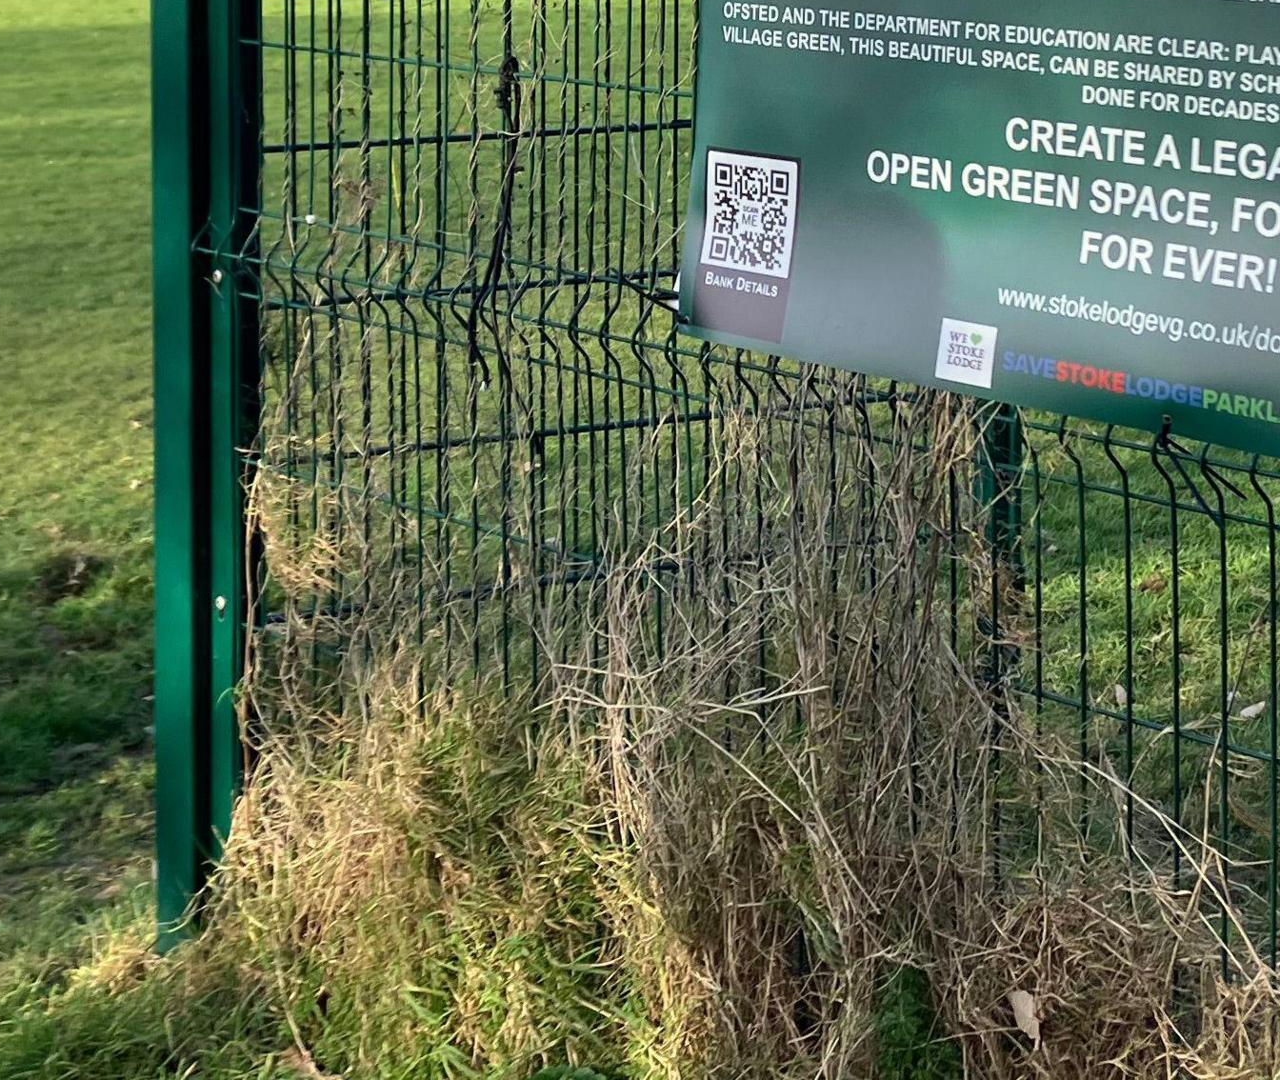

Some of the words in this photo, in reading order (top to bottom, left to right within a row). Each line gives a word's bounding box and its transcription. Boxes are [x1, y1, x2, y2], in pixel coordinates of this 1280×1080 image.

[723, 1, 780, 23] OFSTED
[781, 6, 816, 26] AND
[818, 9, 851, 29] THE
[854, 12, 962, 39] DEPARTMENT
[964, 21, 1001, 43] FOR
[1004, 24, 1111, 52] EDUCATION
[1112, 33, 1154, 55] ARE
[1157, 37, 1230, 62] CLEAR:
[722, 25, 783, 48] VILLAGE
[786, 31, 845, 56] GREEN,
[848, 36, 885, 57] THIS
[888, 40, 978, 67] BEAUTIFUL
[981, 49, 1046, 76] SPACE,
[1049, 55, 1090, 77] CAN
[1093, 58, 1120, 80] BE
[1123, 61, 1204, 87] SHARED
[1207, 69, 1237, 90] BY
[1082, 85, 1136, 109] DONE
[1139, 90, 1180, 113] FOR
[1184, 95, 1280, 124] DECADES
[1005, 117, 1146, 166] CREATE
[1152, 134, 1182, 170] A
[866, 150, 953, 193] OPEN
[961, 162, 1080, 210] GREEN
[1089, 179, 1219, 236] SPACE,
[741, 214, 758, 227] ME
[1079, 230, 1154, 275] FOR
[1162, 243, 1278, 294] EVER!
[947, 343, 985, 359] STOKE
[949, 331, 968, 344] WE
[946, 355, 983, 370] LODGE
